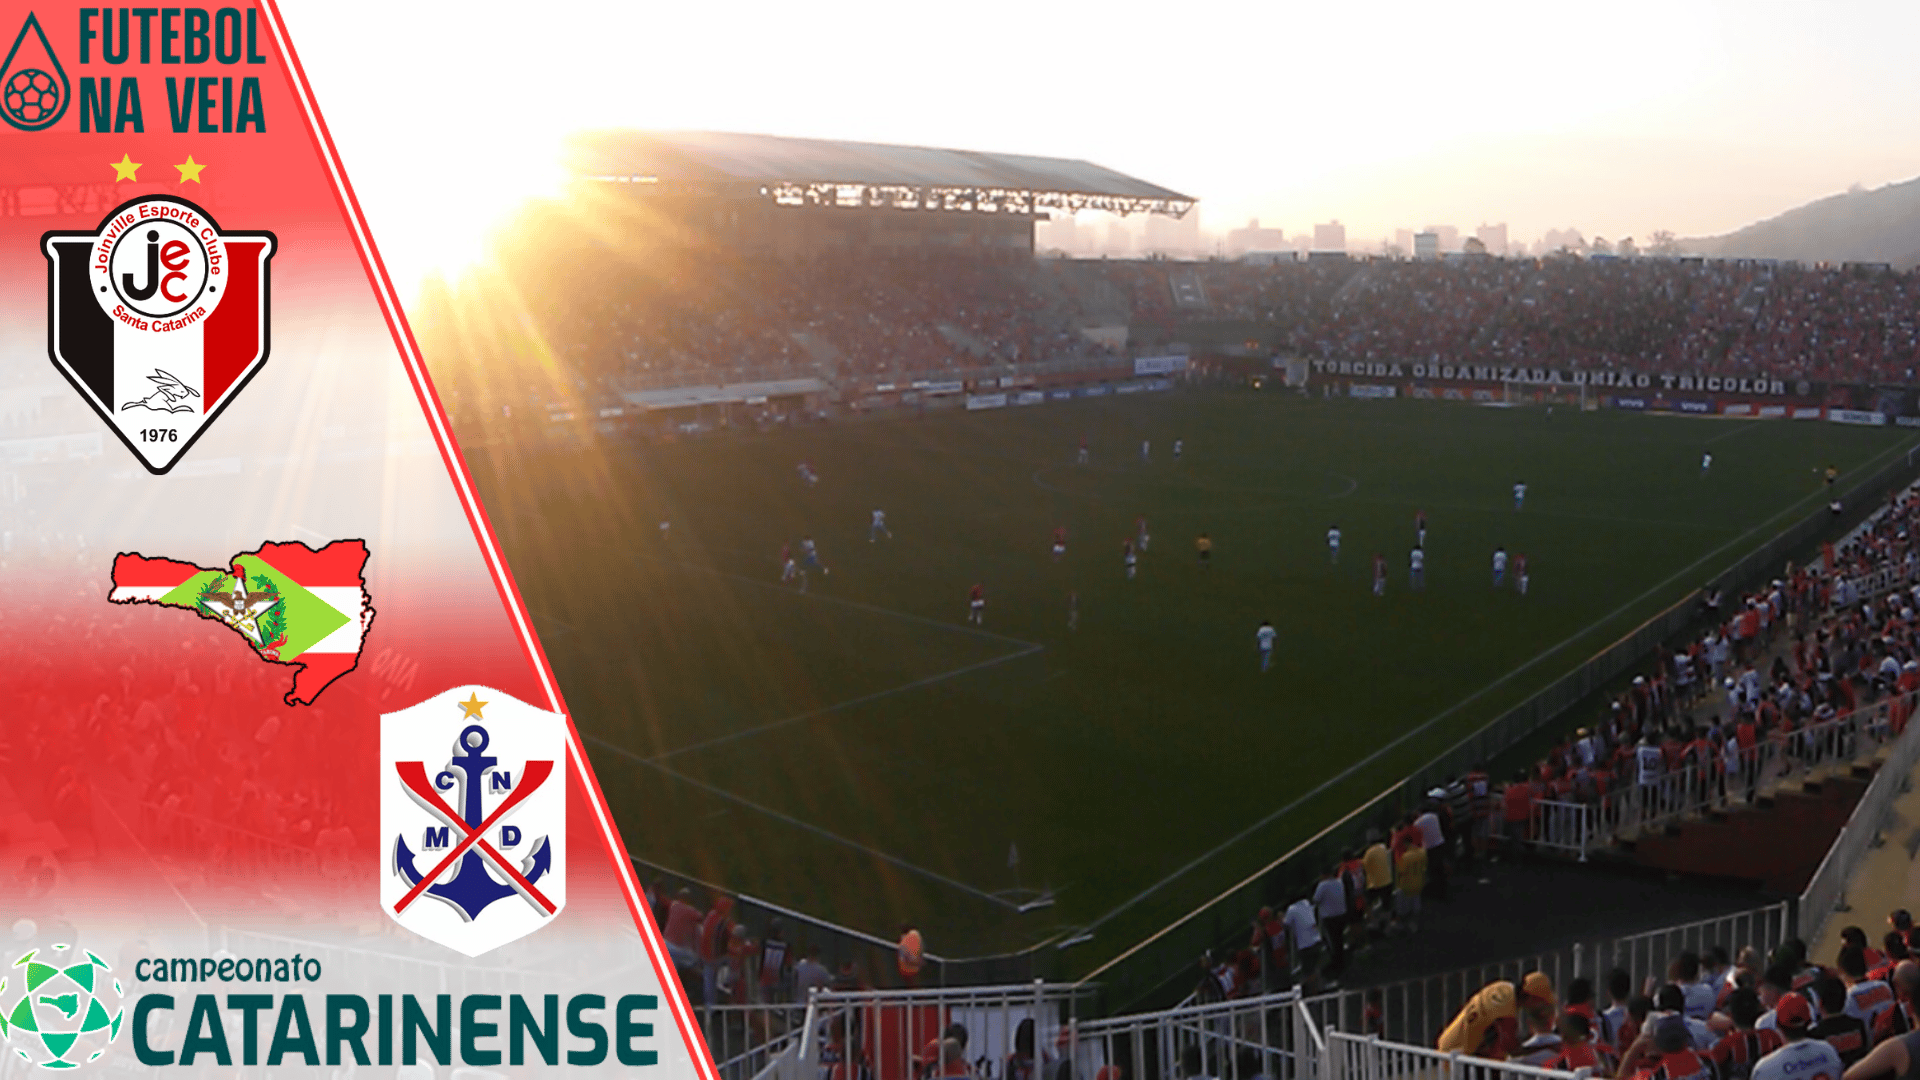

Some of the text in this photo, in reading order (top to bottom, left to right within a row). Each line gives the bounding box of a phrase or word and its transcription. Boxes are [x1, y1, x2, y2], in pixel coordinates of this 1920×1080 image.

[1313, 359, 1403, 378] TORCIDA
[1412, 362, 1561, 384] ORGANIZADA
[1660, 372, 1786, 395] TRICOLOR
